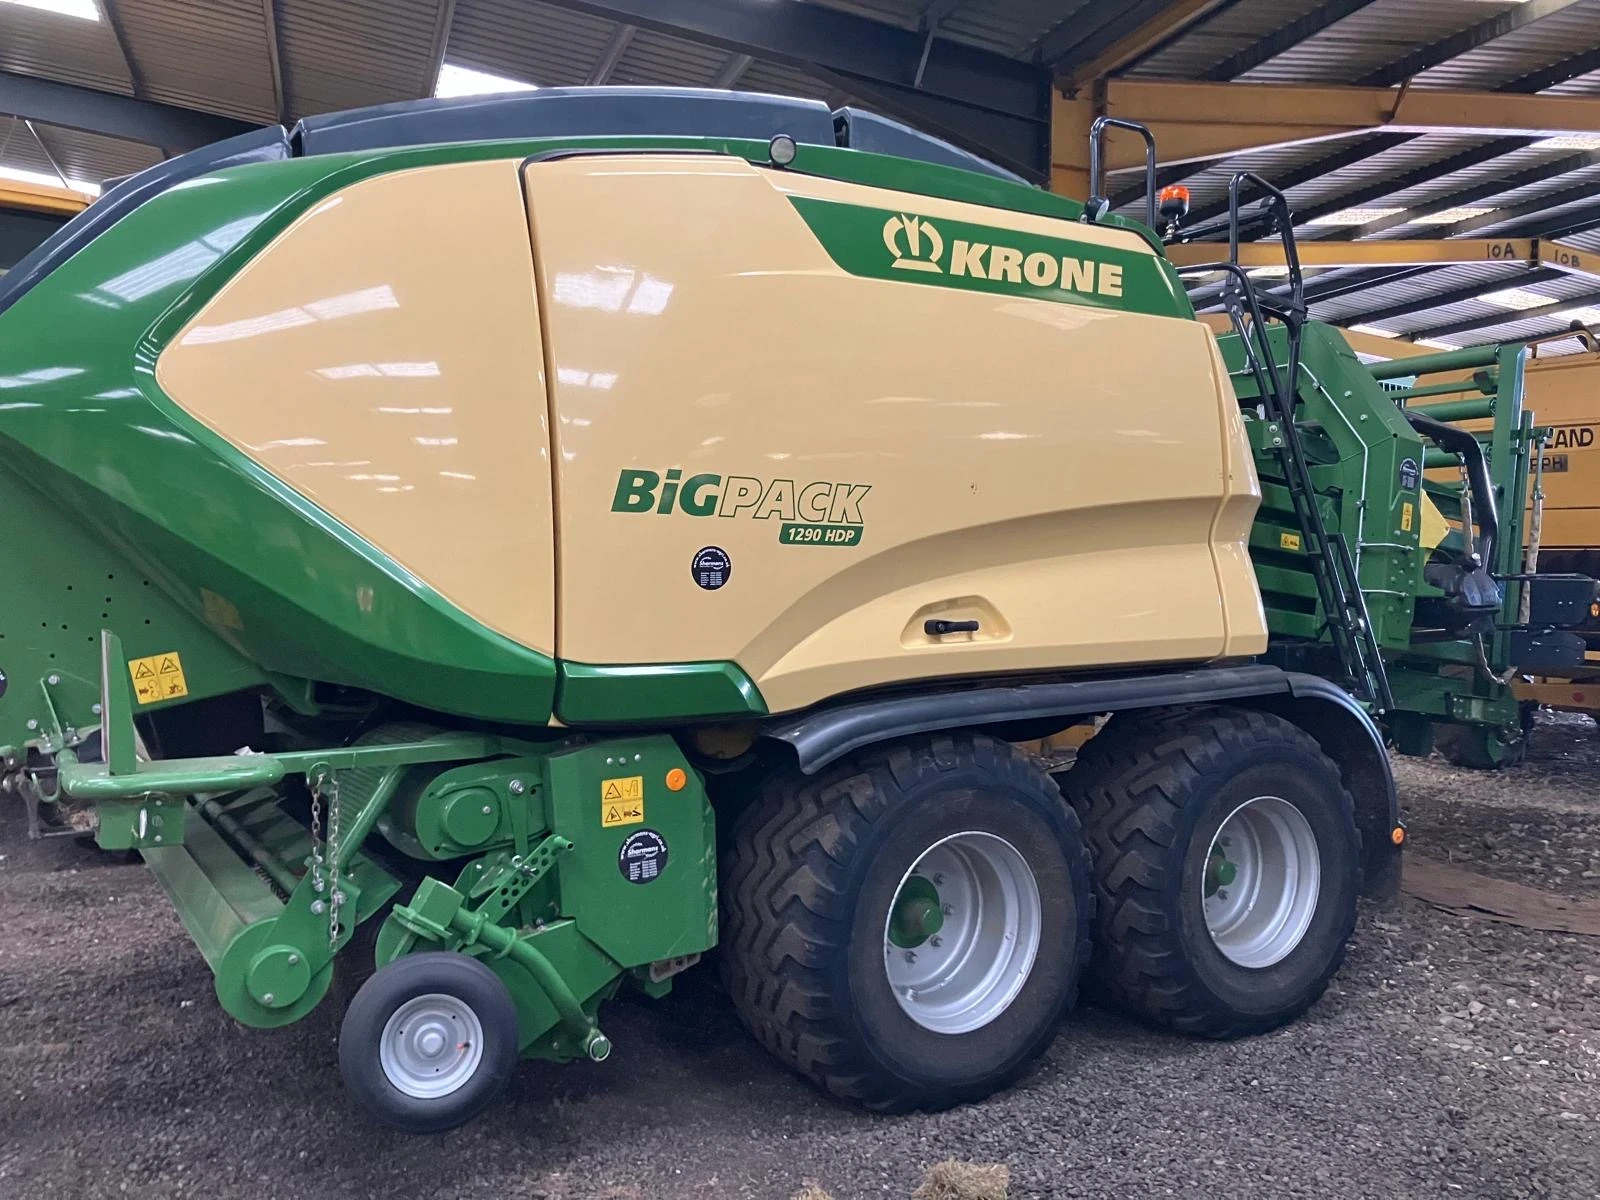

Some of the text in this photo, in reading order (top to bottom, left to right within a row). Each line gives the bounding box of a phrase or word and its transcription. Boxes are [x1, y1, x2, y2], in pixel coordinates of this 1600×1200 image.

[1486, 243, 1515, 258] 10A
[1555, 249, 1580, 267] 10B
[950, 240, 1123, 297] KRONE
[788, 527, 855, 543] 1290 HDP
